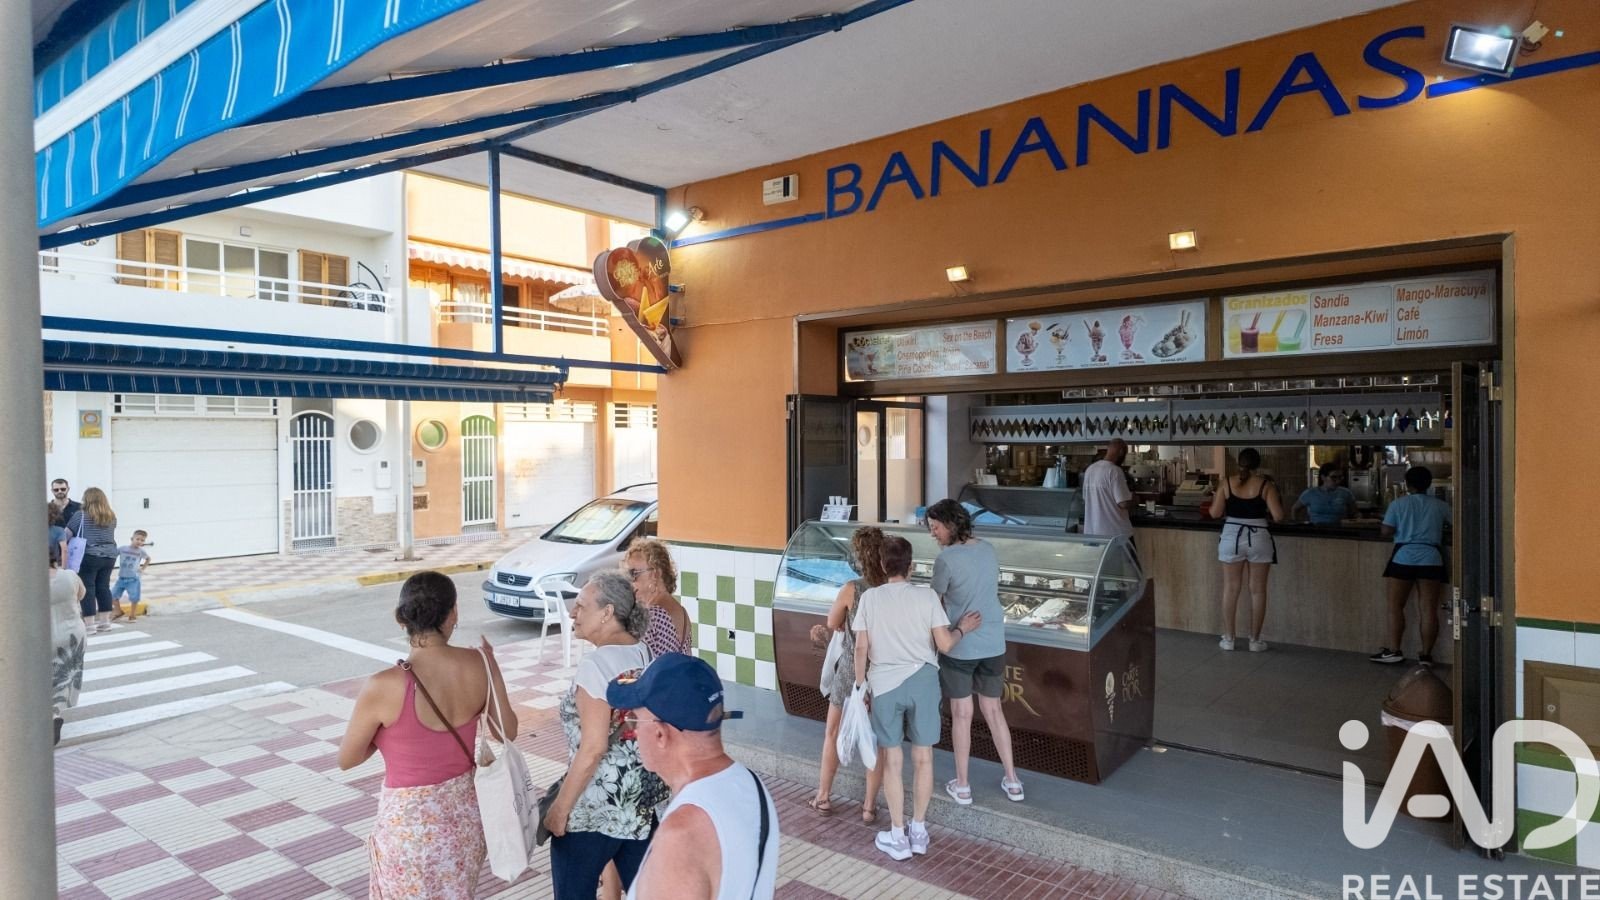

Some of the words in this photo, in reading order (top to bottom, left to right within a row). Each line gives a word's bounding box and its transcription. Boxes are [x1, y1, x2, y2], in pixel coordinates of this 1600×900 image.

[824, 26, 1426, 220] BANANNAS
[1228, 293, 1308, 311] Granizados
[1313, 308, 1389, 328] Manzana-Kiwi
[1397, 305, 1420, 321] Café
[1313, 333, 1343, 346] Fresa
[1396, 326, 1429, 341] Limón
